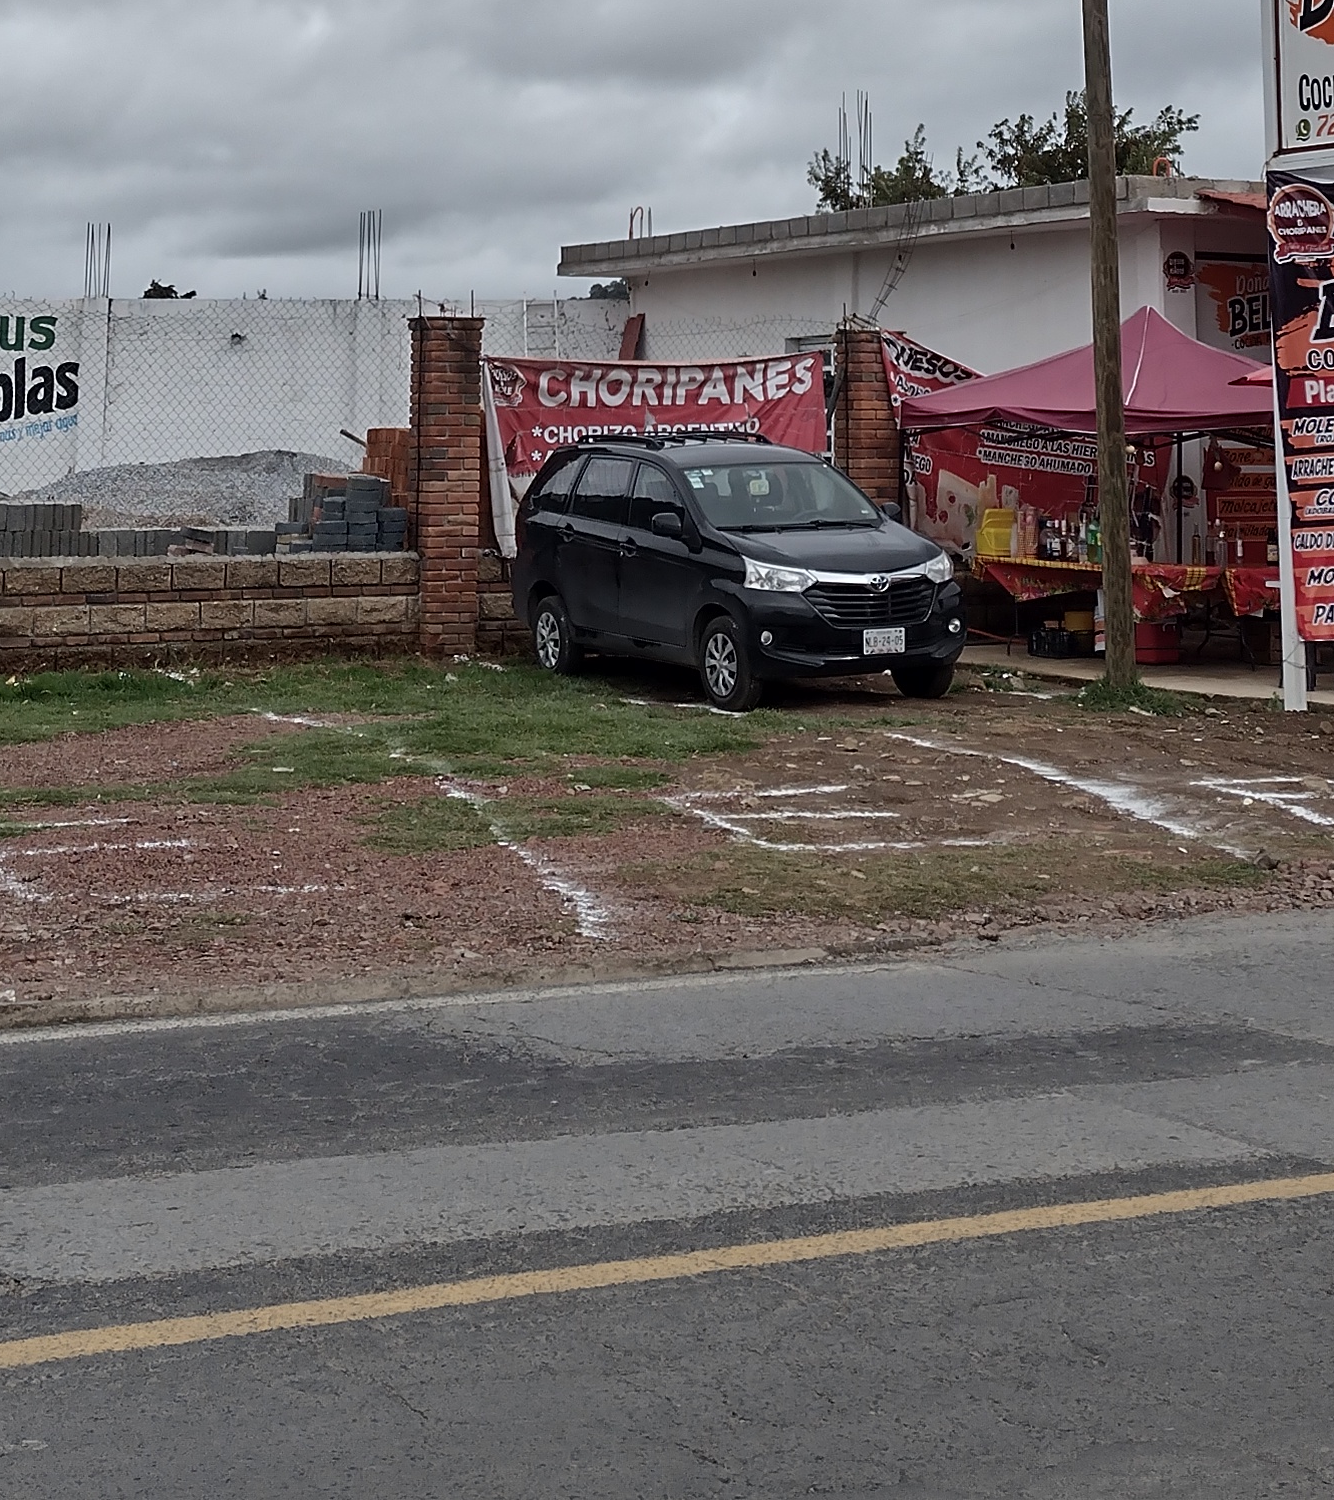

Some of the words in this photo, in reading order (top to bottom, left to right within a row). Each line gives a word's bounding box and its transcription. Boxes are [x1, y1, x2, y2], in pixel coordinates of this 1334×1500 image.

[537, 357, 816, 407] CHORIPANES
[1039, 457, 1092, 475] AHUMADO
[1295, 531, 1323, 550] CALDO
